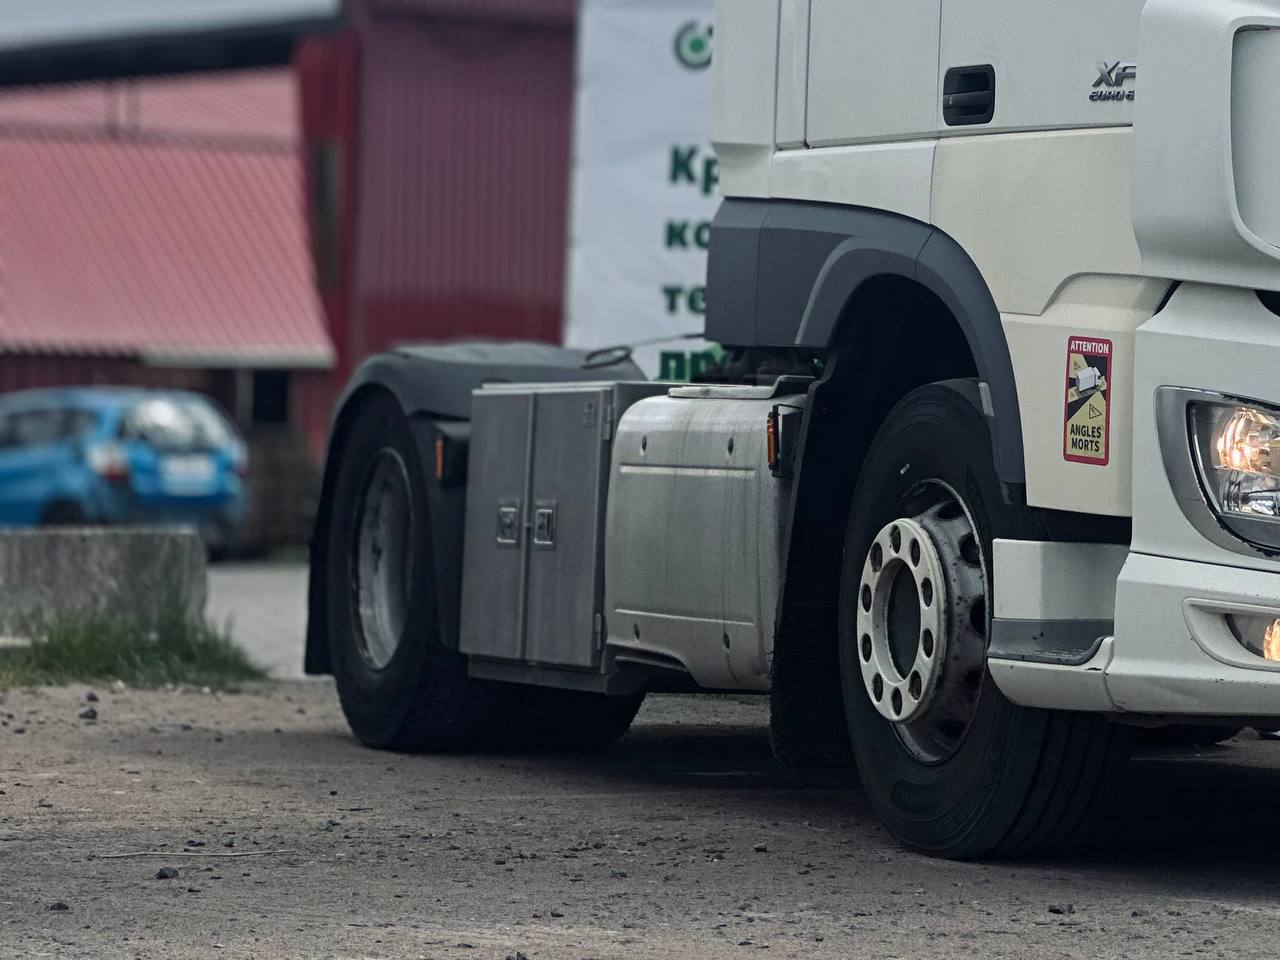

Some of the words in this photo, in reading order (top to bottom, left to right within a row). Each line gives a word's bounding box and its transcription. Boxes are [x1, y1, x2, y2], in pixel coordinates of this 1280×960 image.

[1092, 60, 1137, 88] XF
[1070, 340, 1109, 354] ATTENTION
[1070, 423, 1102, 439] ANGLES
[1071, 438, 1100, 452] MORTS
